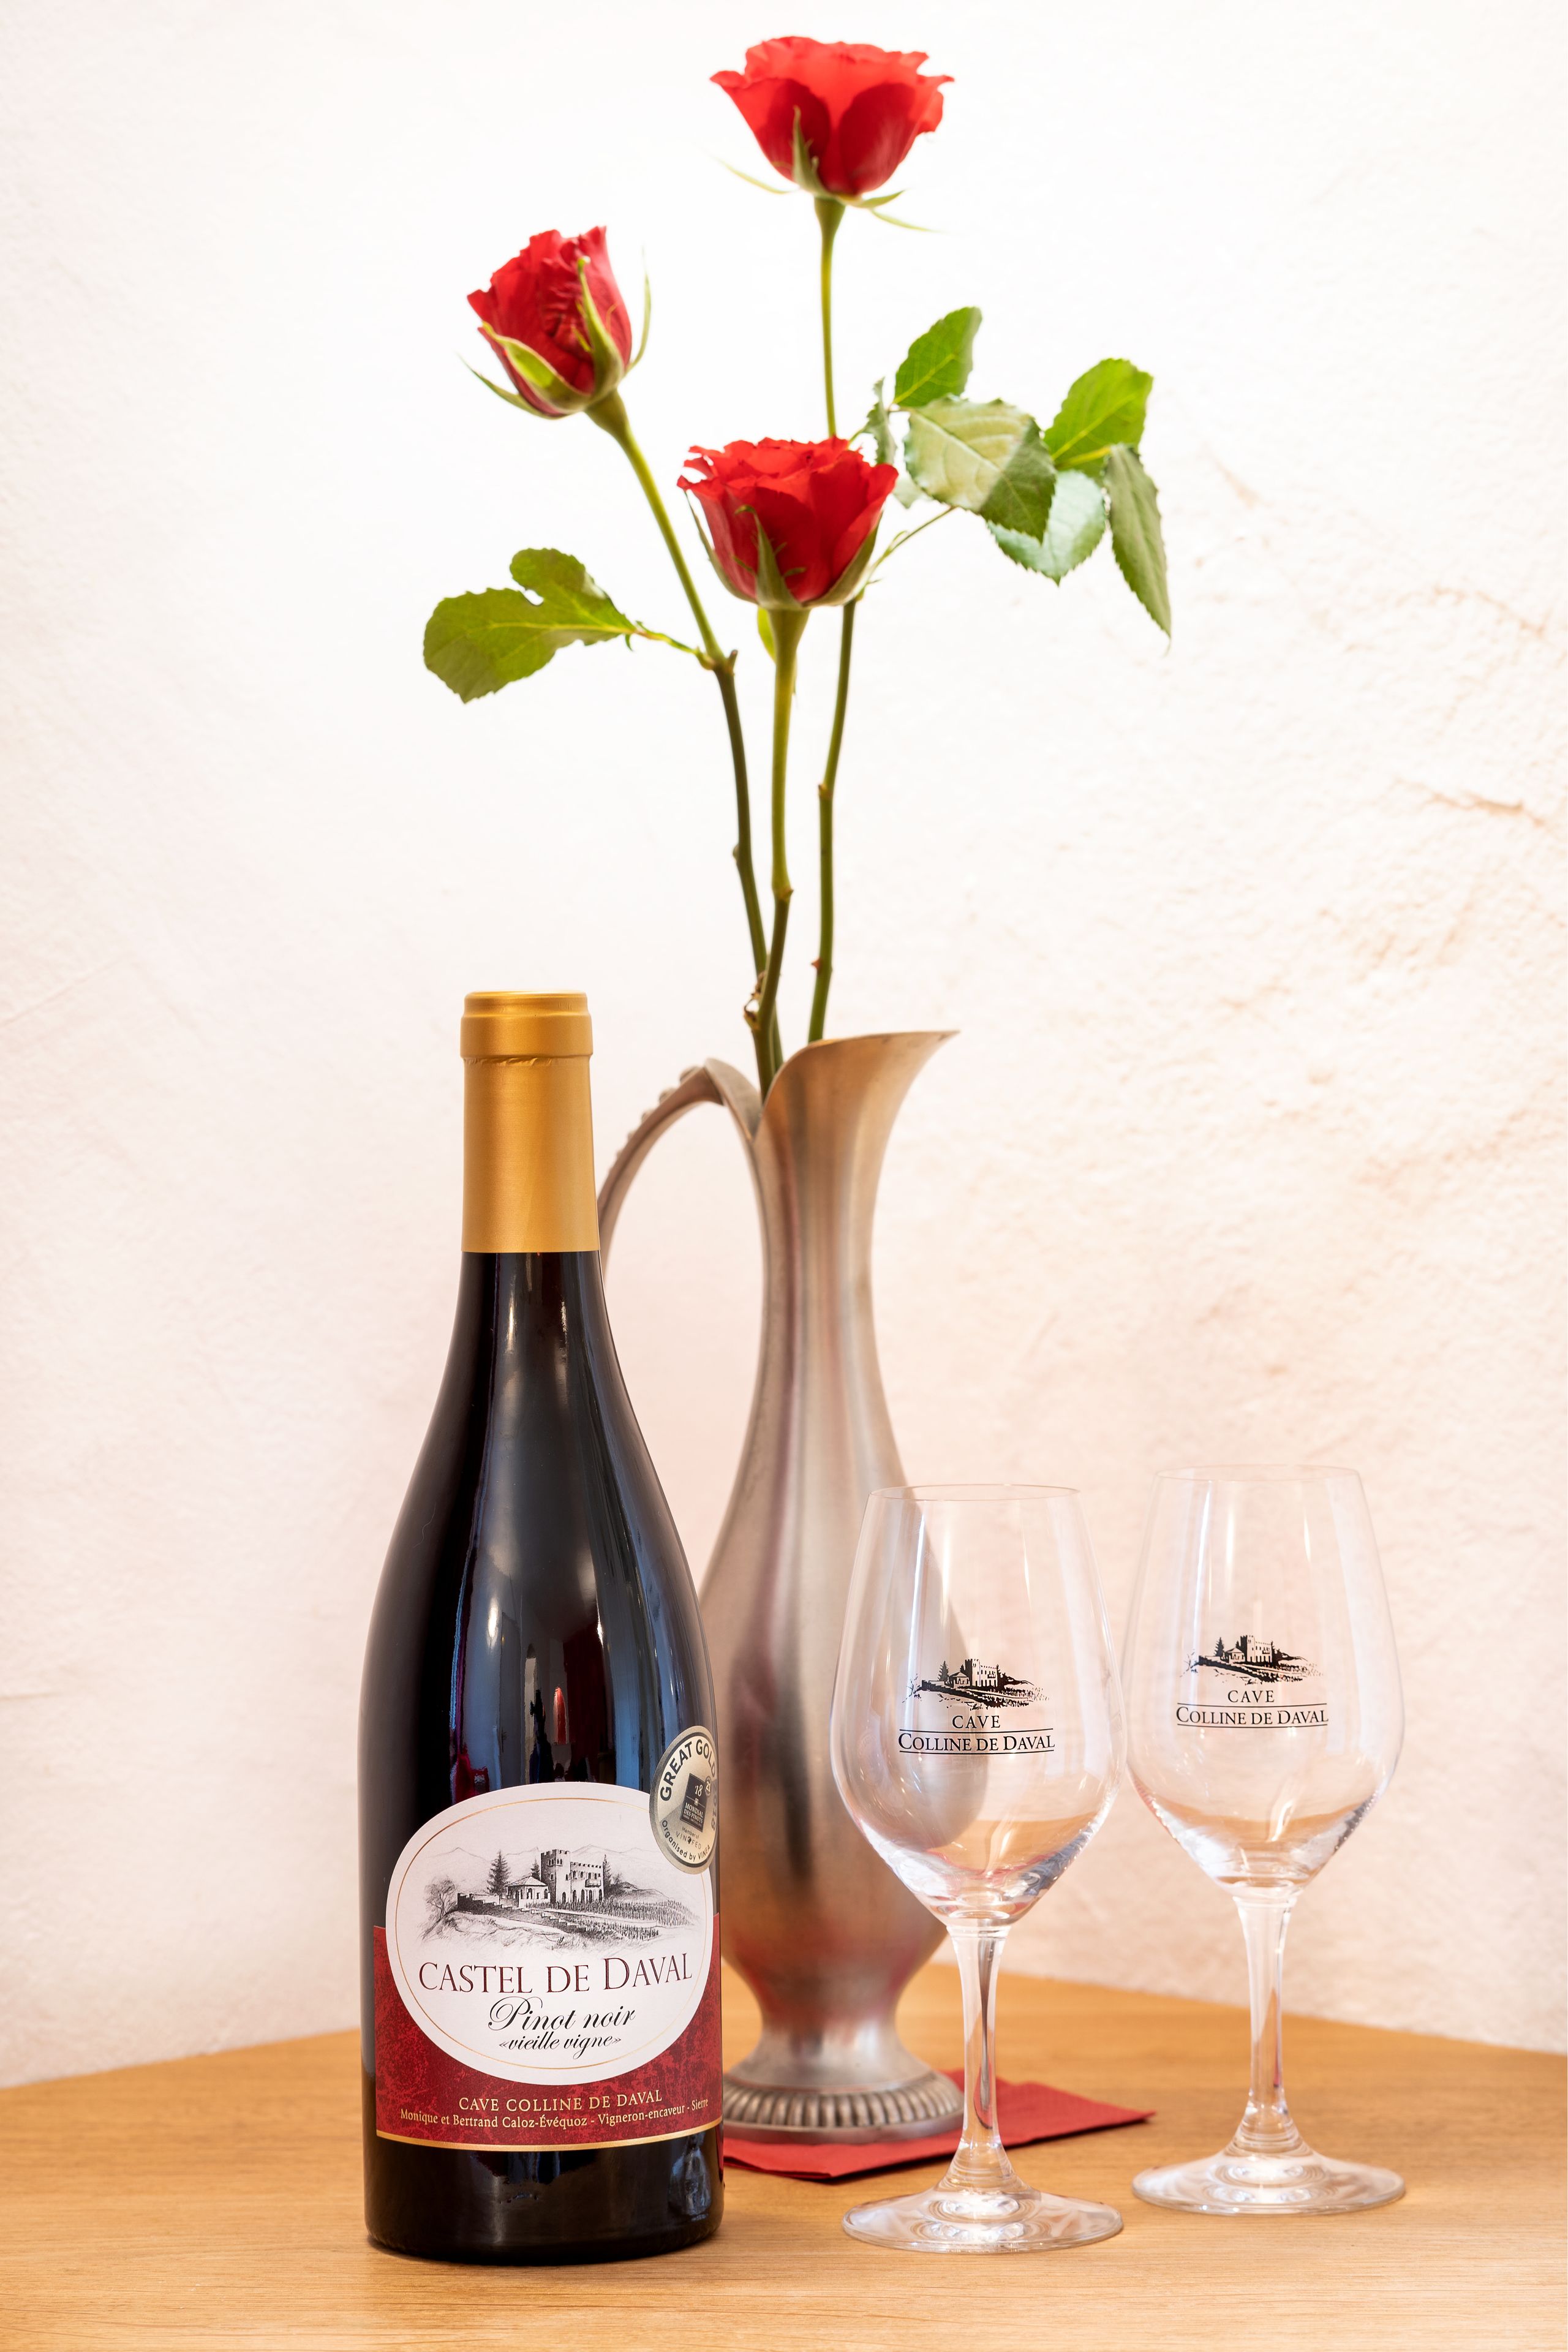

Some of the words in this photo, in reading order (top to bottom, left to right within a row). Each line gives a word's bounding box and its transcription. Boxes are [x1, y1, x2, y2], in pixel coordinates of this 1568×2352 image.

[1227, 1690, 1274, 1703] CAVE
[952, 1715, 1001, 1728] CAVE
[1176, 1706, 1246, 1724] COLLINE
[1251, 1713, 1273, 1725] DE
[1278, 1710, 1329, 1724] DAVAL
[898, 1733, 971, 1751] COLLINE
[976, 1738, 998, 1751] DE
[1003, 1735, 1055, 1751] DAVAL
[660, 1741, 692, 1801] GREAT
[696, 1740, 715, 1777] GOLD
[695, 1784, 703, 1796] 18
[685, 1803, 703, 1818] MONDIAL
[691, 1812, 703, 1823] PINOTS
[662, 1820, 687, 1858] Organised
[689, 1853, 696, 1861] by
[698, 1844, 710, 1860] VINEA
[682, 1826, 695, 1837] Member
[419, 1962, 532, 1993] CASTEL
[546, 1964, 590, 1993] DE
[603, 1953, 693, 1990] DAVAL
[488, 1996, 576, 2031] Pinot
[583, 2006, 636, 2030] noir
[459, 2097, 499, 2111] CAVE
[506, 2097, 582, 2112] COLLINE
[589, 2095, 611, 2109] DE
[617, 2090, 662, 2107] DAVAL
[401, 2109, 438, 2125] Monique
[441, 2115, 450, 2125] et
[453, 2114, 498, 2127] Bertrand
[502, 2114, 587, 2130] Caloz-Évéquoz
[598, 2105, 685, 2127] Vigneron-encaveur
[692, 2098, 709, 2111] Sierre
